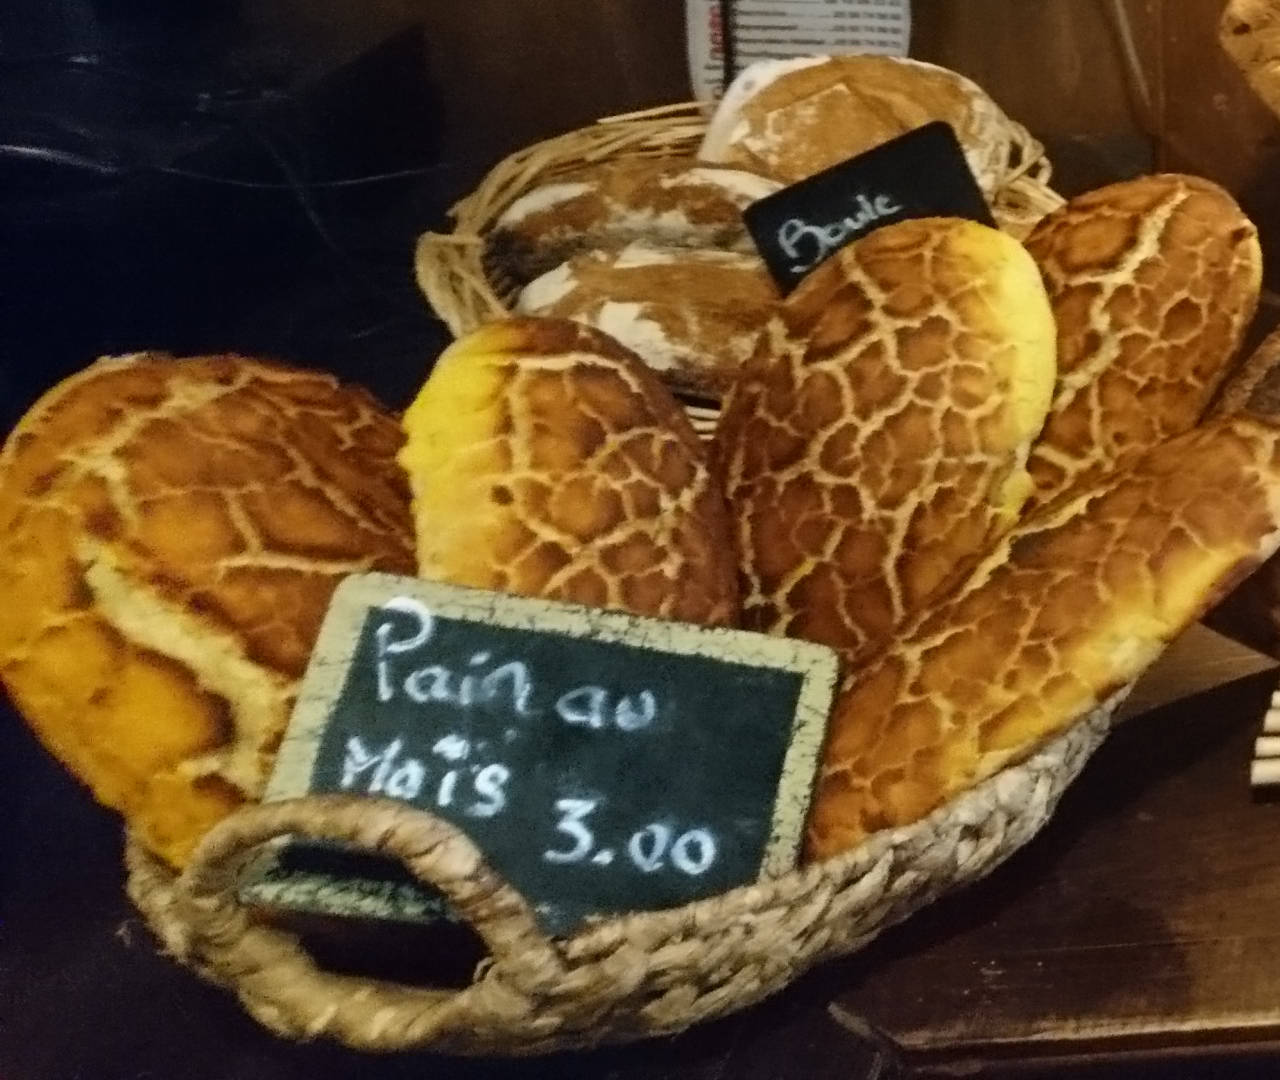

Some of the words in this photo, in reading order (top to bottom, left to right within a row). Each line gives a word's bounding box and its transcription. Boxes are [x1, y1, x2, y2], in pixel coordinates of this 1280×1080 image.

[375, 596, 536, 716] Pain
[555, 685, 657, 732] au
[544, 797, 718, 876] 3.00
